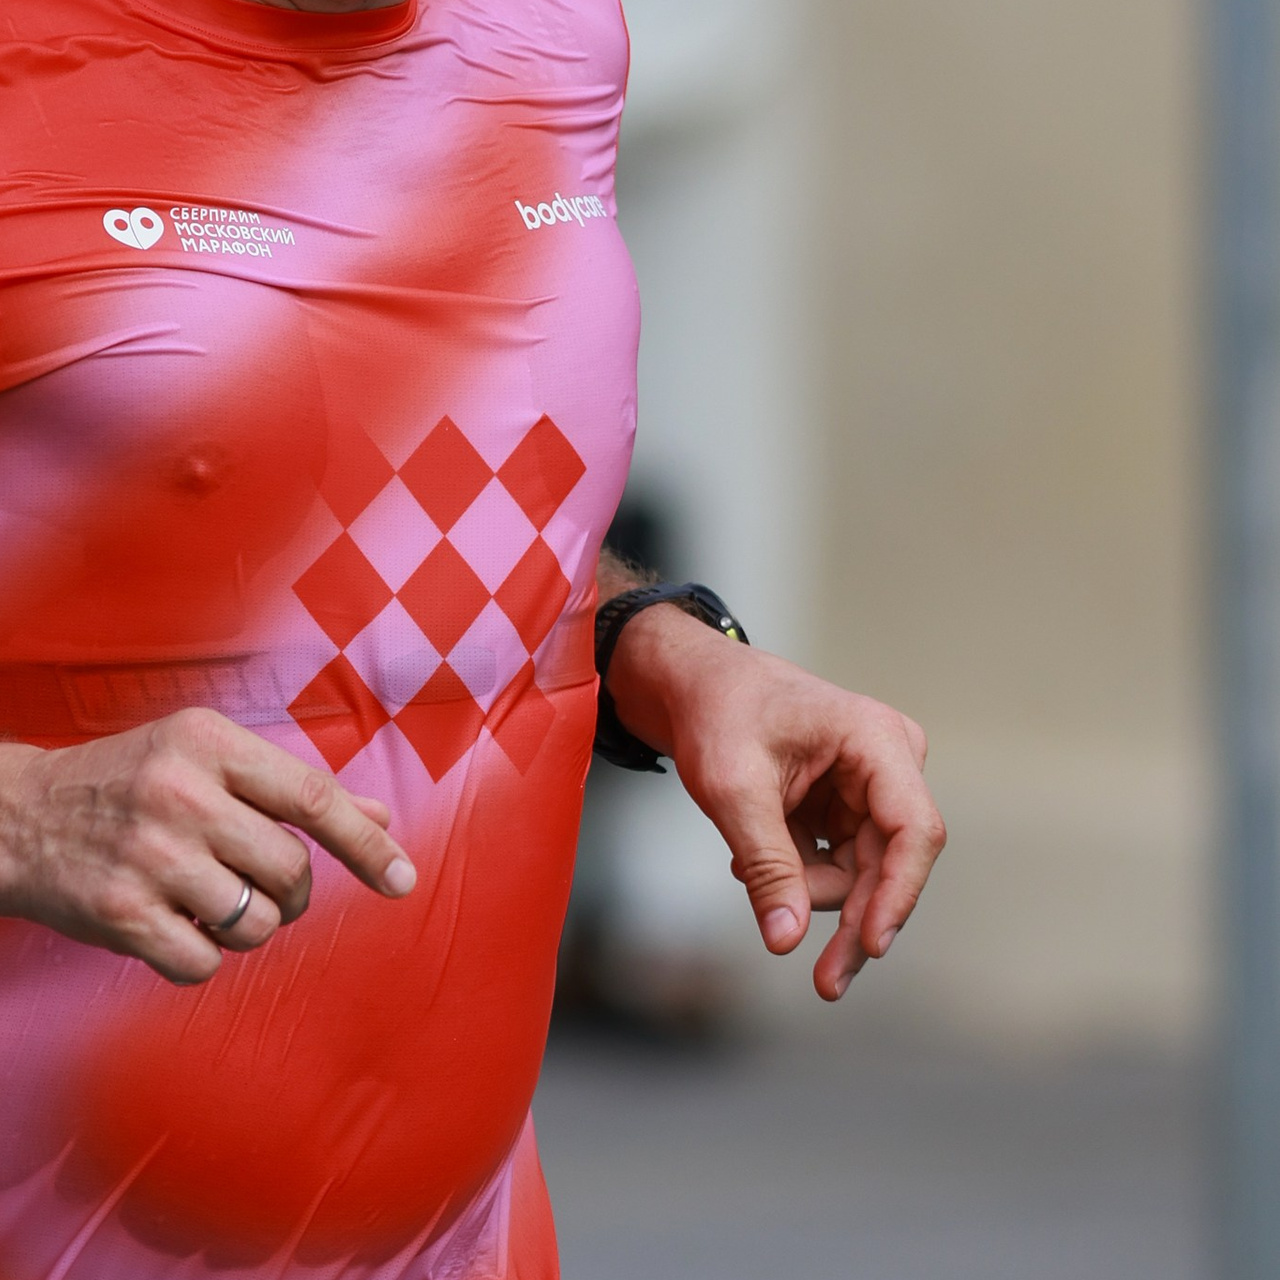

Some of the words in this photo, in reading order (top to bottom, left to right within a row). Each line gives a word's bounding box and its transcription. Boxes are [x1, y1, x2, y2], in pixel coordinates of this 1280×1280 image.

[169, 207, 261, 224] СБЕРПРАЙМ
[173, 222, 295, 246] МОСКОВСКИЙ
[180, 237, 273, 258] МАРАФОН
